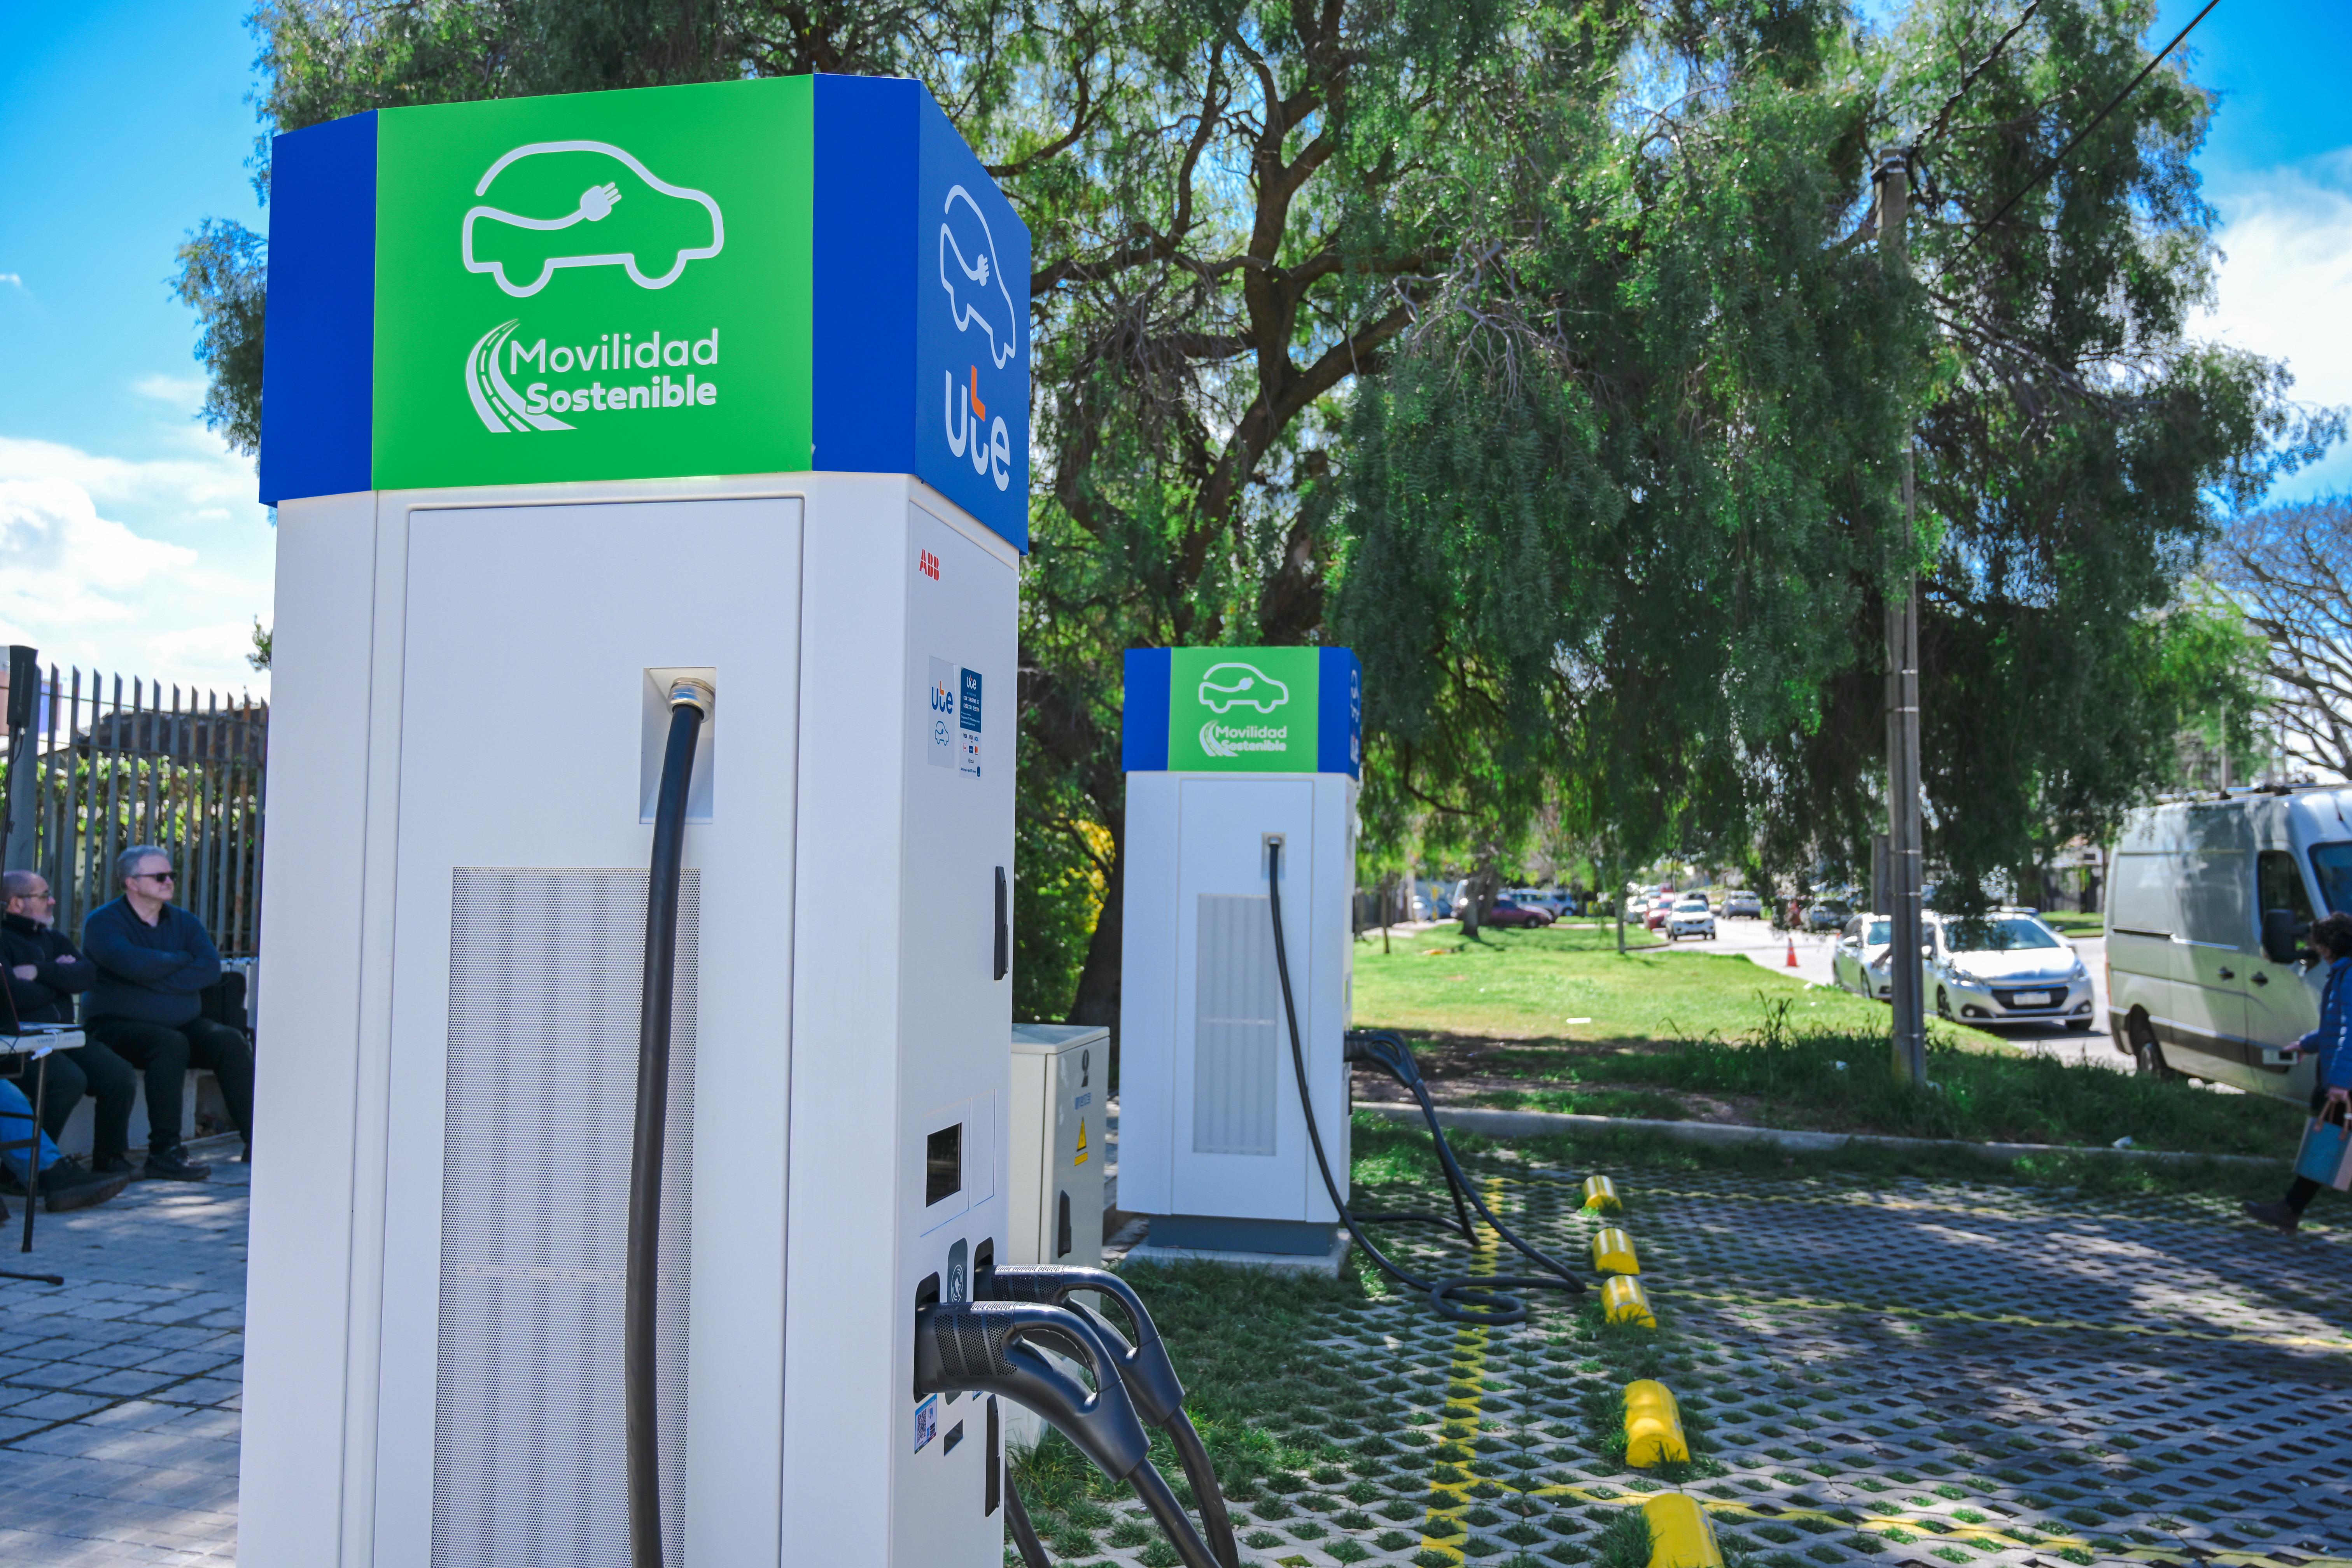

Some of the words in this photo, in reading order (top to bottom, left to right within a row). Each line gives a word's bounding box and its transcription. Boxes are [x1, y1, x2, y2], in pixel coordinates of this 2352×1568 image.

[510, 327, 718, 375] Movilidad
[526, 374, 717, 414] Sostenible
[919, 549, 940, 581] ABB
[1215, 725, 1287, 738] Movilidad
[1221, 739, 1286, 751] Sostenible
